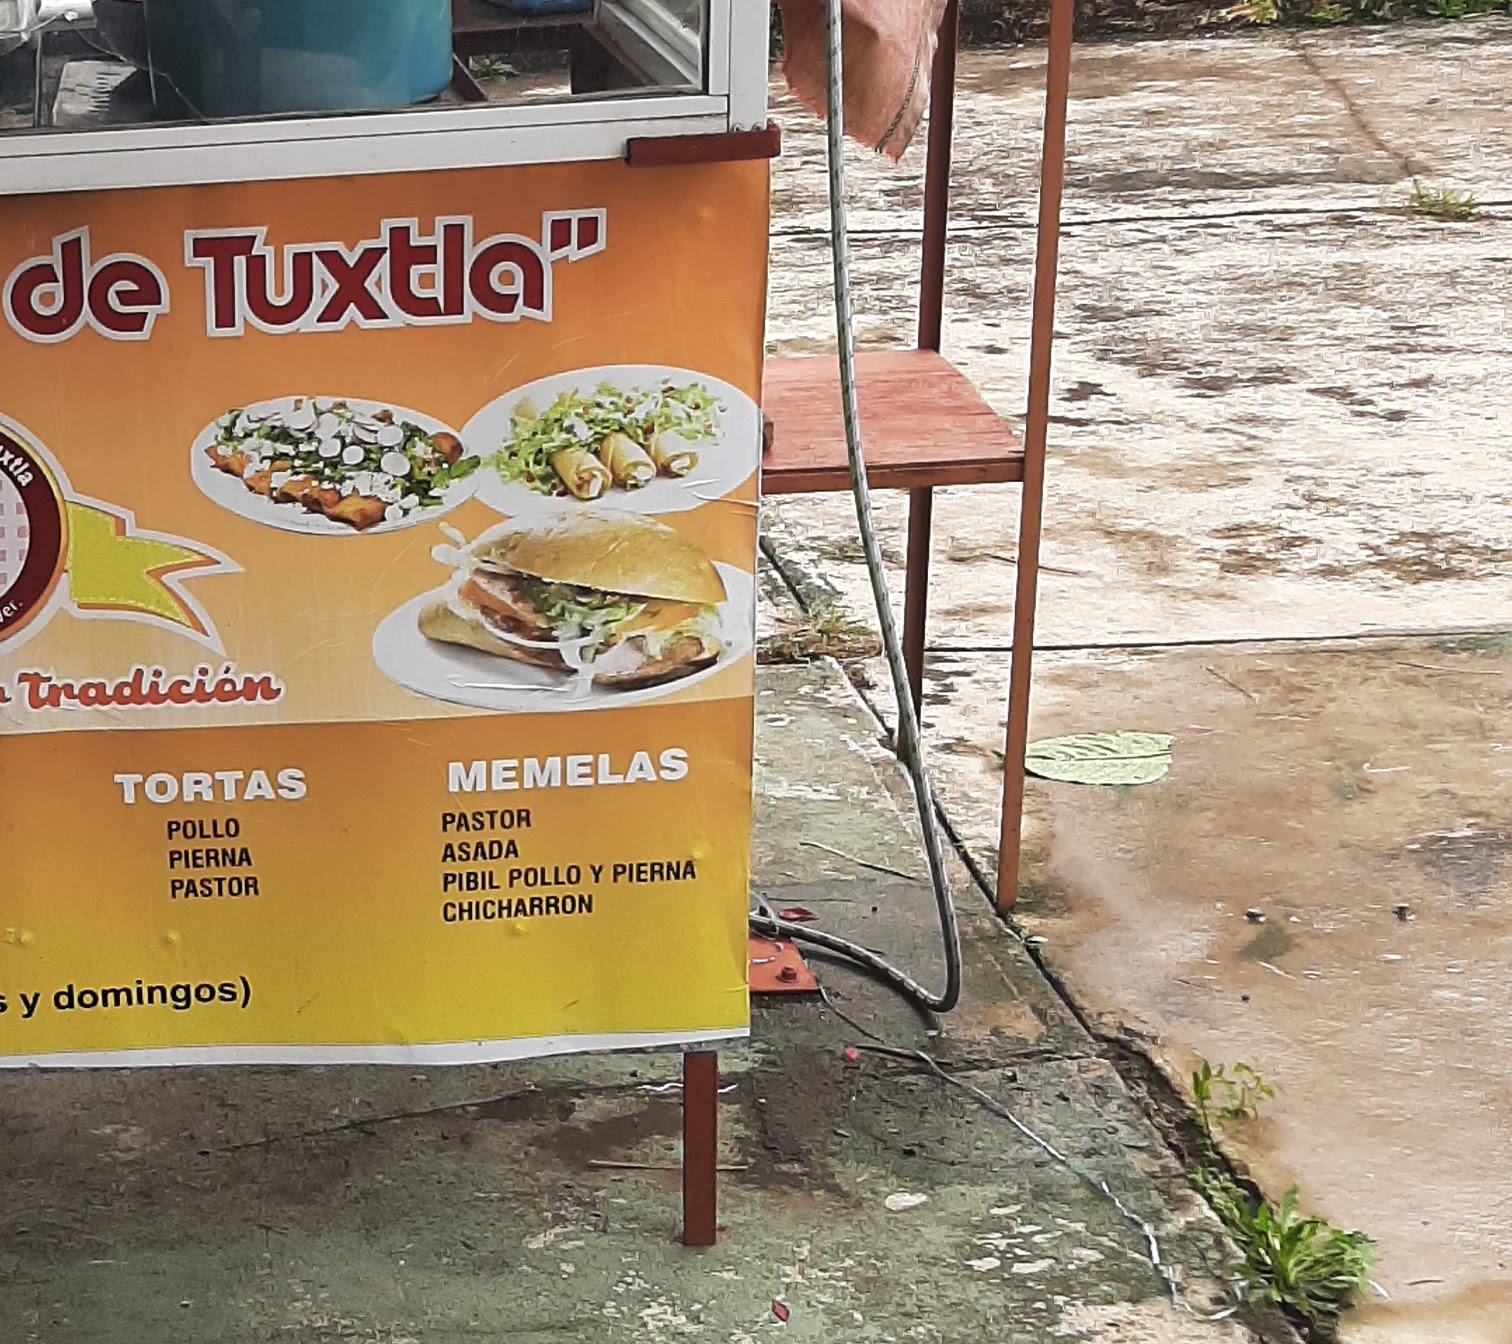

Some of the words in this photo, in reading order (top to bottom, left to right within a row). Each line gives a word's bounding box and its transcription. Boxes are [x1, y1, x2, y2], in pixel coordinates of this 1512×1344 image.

[6, 231, 165, 337] de
[189, 212, 602, 332] Tuxtla"
[447, 747, 690, 793] MEMELAS
[114, 768, 308, 804] TORTAS
[167, 818, 240, 840] POLLO
[441, 809, 532, 832] PASTOR
[169, 848, 253, 870] PIERNA
[441, 839, 520, 863] ASADA
[170, 876, 260, 899] PASTOR
[442, 870, 501, 893] PIBIL
[508, 864, 582, 889] POLLO
[589, 864, 604, 884] Y
[612, 860, 697, 883] PIERNA
[442, 894, 594, 922] CHICHARRON
[20, 989, 40, 1018] y
[53, 975, 252, 1011] domingos)
